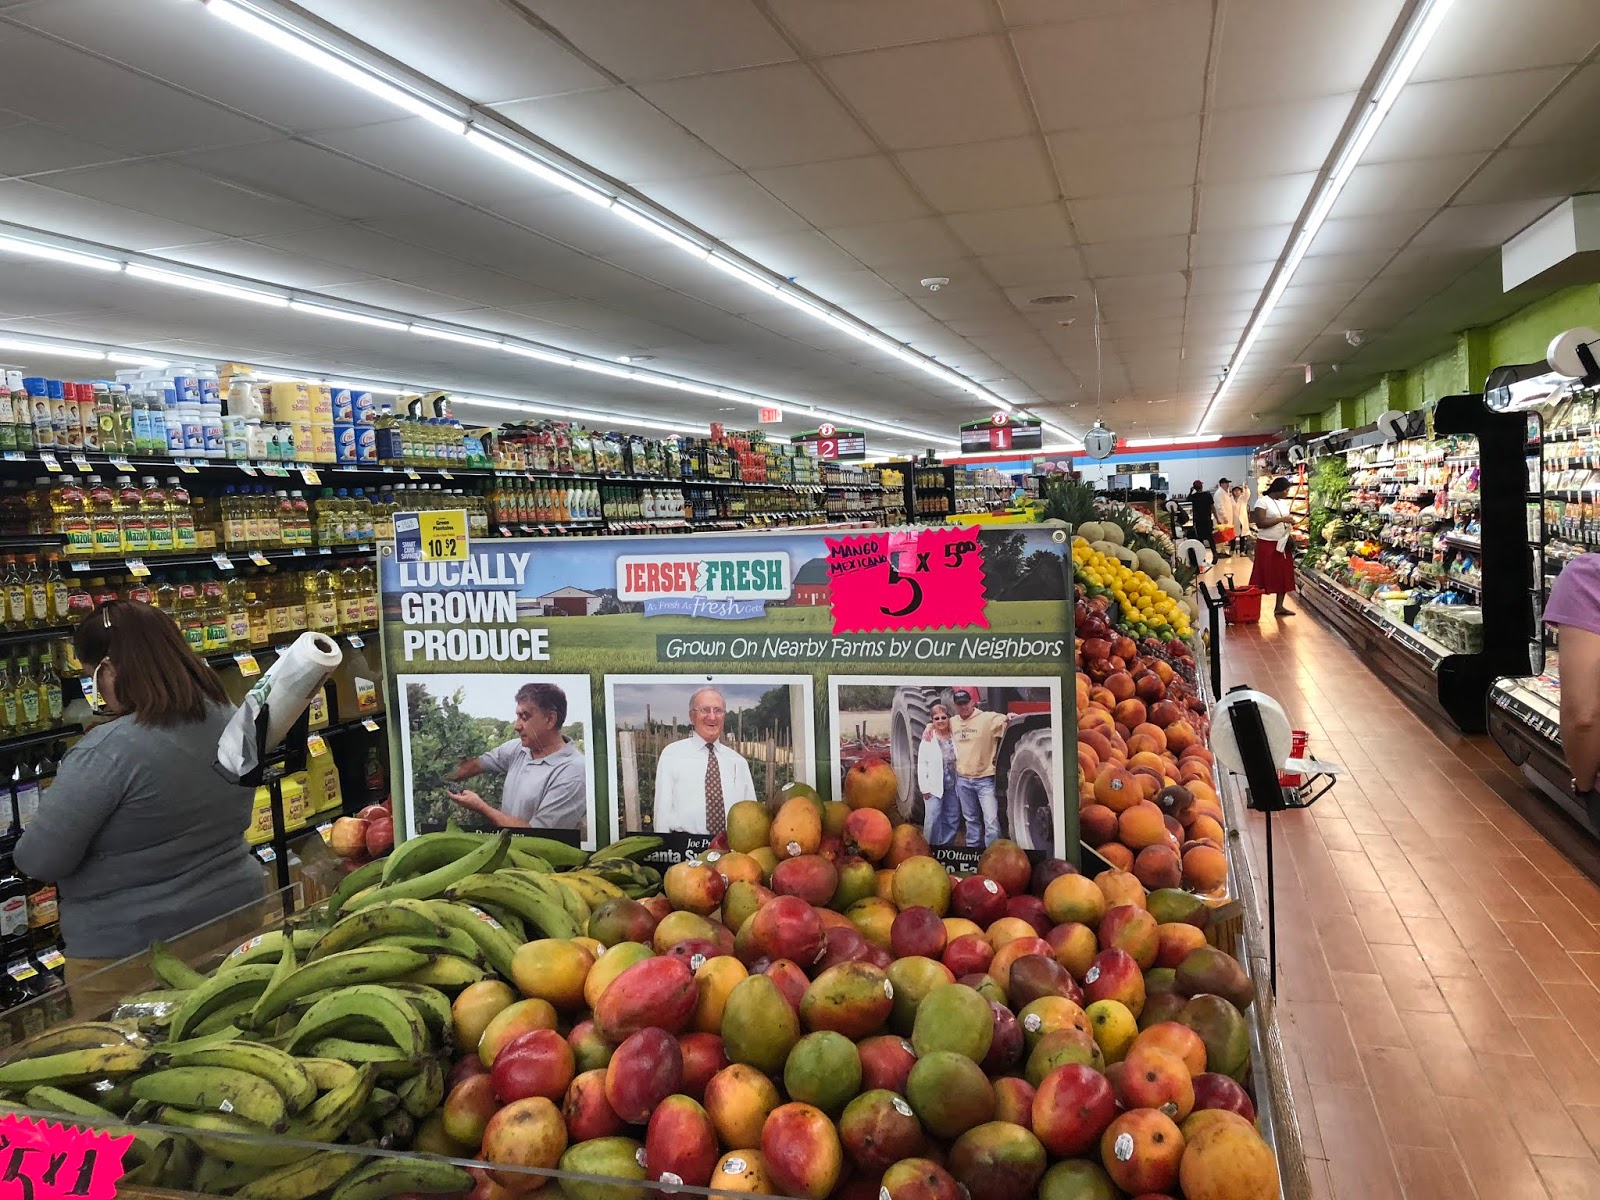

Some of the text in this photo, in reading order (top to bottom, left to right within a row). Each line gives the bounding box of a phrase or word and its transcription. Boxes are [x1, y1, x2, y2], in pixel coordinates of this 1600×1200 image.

[762, 408, 777, 421] EXIT
[995, 429, 1007, 448] 1
[821, 441, 835, 458] 2
[178, 529, 193, 539] Mazol
[428, 538, 457, 557] 10 $2
[831, 541, 879, 558] MANGO
[400, 553, 531, 587] LOCALLY
[830, 555, 888, 574] MEXICANO
[624, 559, 783, 593] JERSEY FRESH
[880, 550, 923, 617] 5
[401, 590, 518, 625] GROWN
[659, 601, 681, 610] Fresh
[682, 602, 692, 610] As
[745, 604, 763, 613] Gets
[207, 627, 227, 641] Mazol
[403, 628, 550, 662] PRODUCE
[666, 637, 1064, 659] Grown On Nearby Farms by Our Neighbors
[687, 838, 700, 849] Joe
